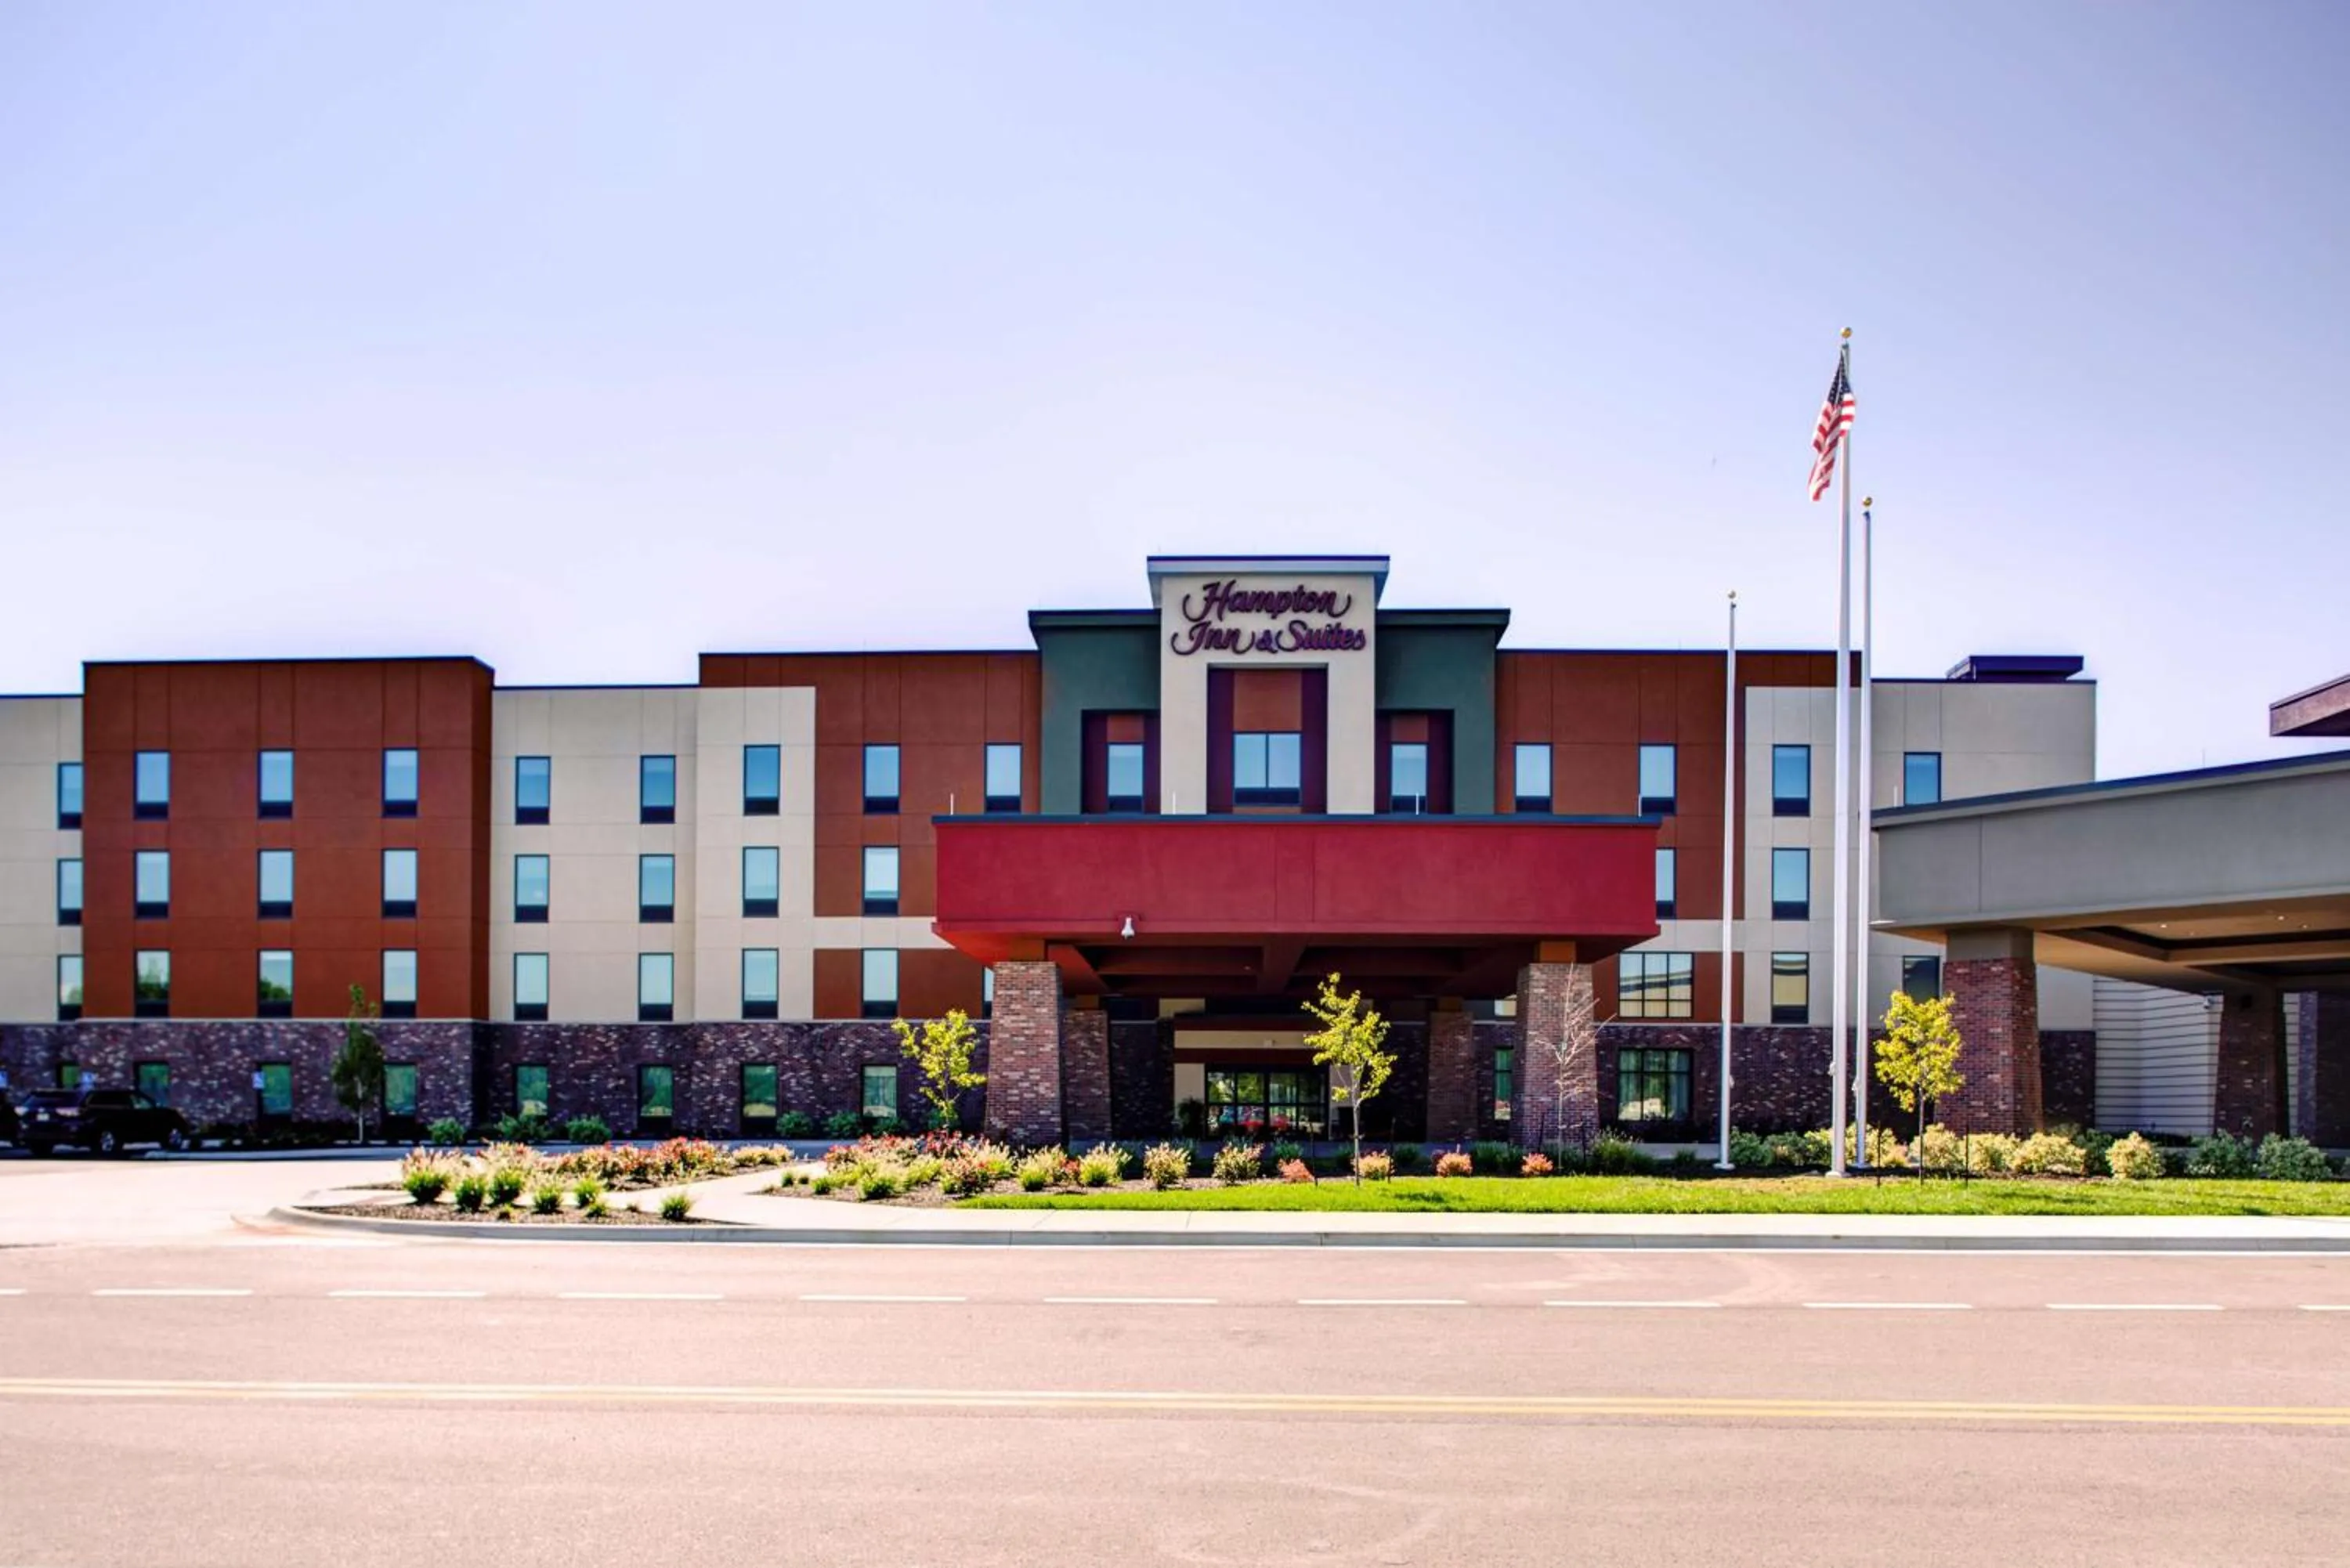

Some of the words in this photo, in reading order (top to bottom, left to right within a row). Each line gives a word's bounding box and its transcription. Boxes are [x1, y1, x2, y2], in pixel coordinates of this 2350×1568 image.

[1182, 580, 1352, 622] Hampton
[1171, 621, 1256, 656] Inn
[1255, 629, 1278, 654] &
[1275, 620, 1367, 652] Suites
